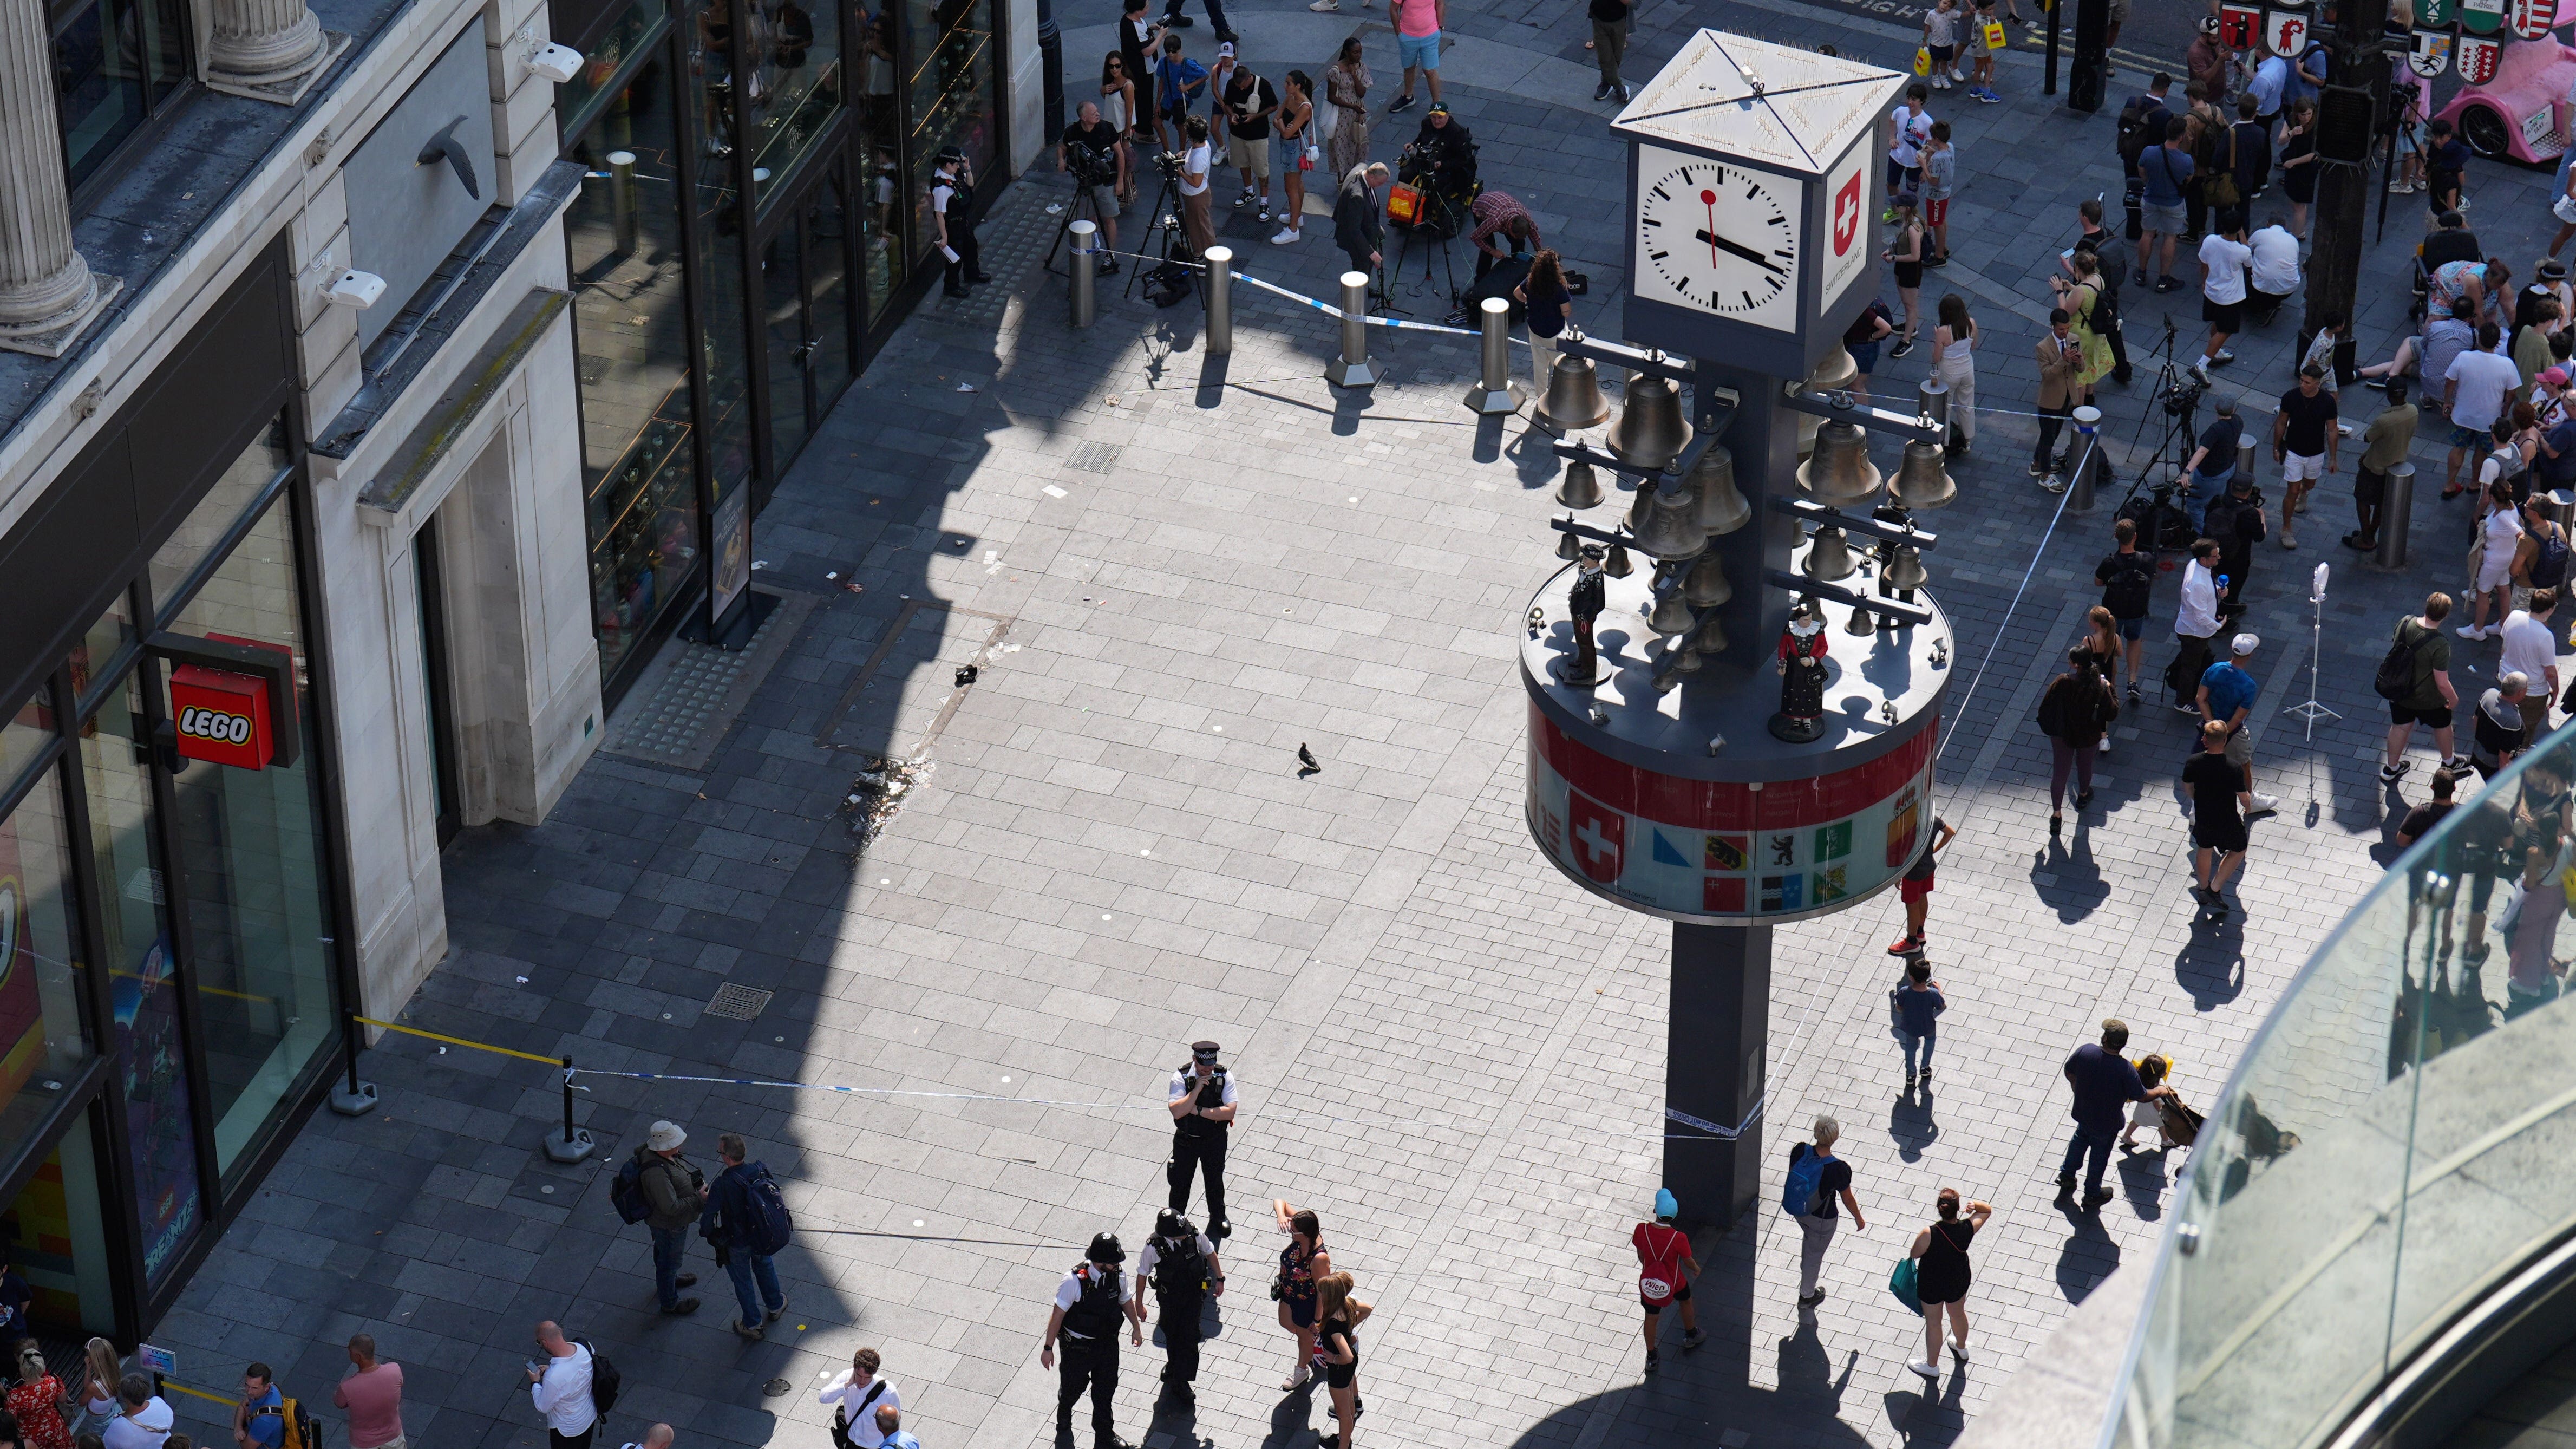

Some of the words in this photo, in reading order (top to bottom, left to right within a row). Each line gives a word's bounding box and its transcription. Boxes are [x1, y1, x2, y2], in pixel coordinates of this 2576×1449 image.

[1825, 246, 1862, 295] SWITZERLAND
[179, 706, 251, 745] LEGO
[1617, 885, 1656, 903] Switzerland
[1673, 1111, 1690, 1122] CROSS
[1691, 1117, 1701, 1125] NOT
[1645, 1280, 1665, 1291] Wien
